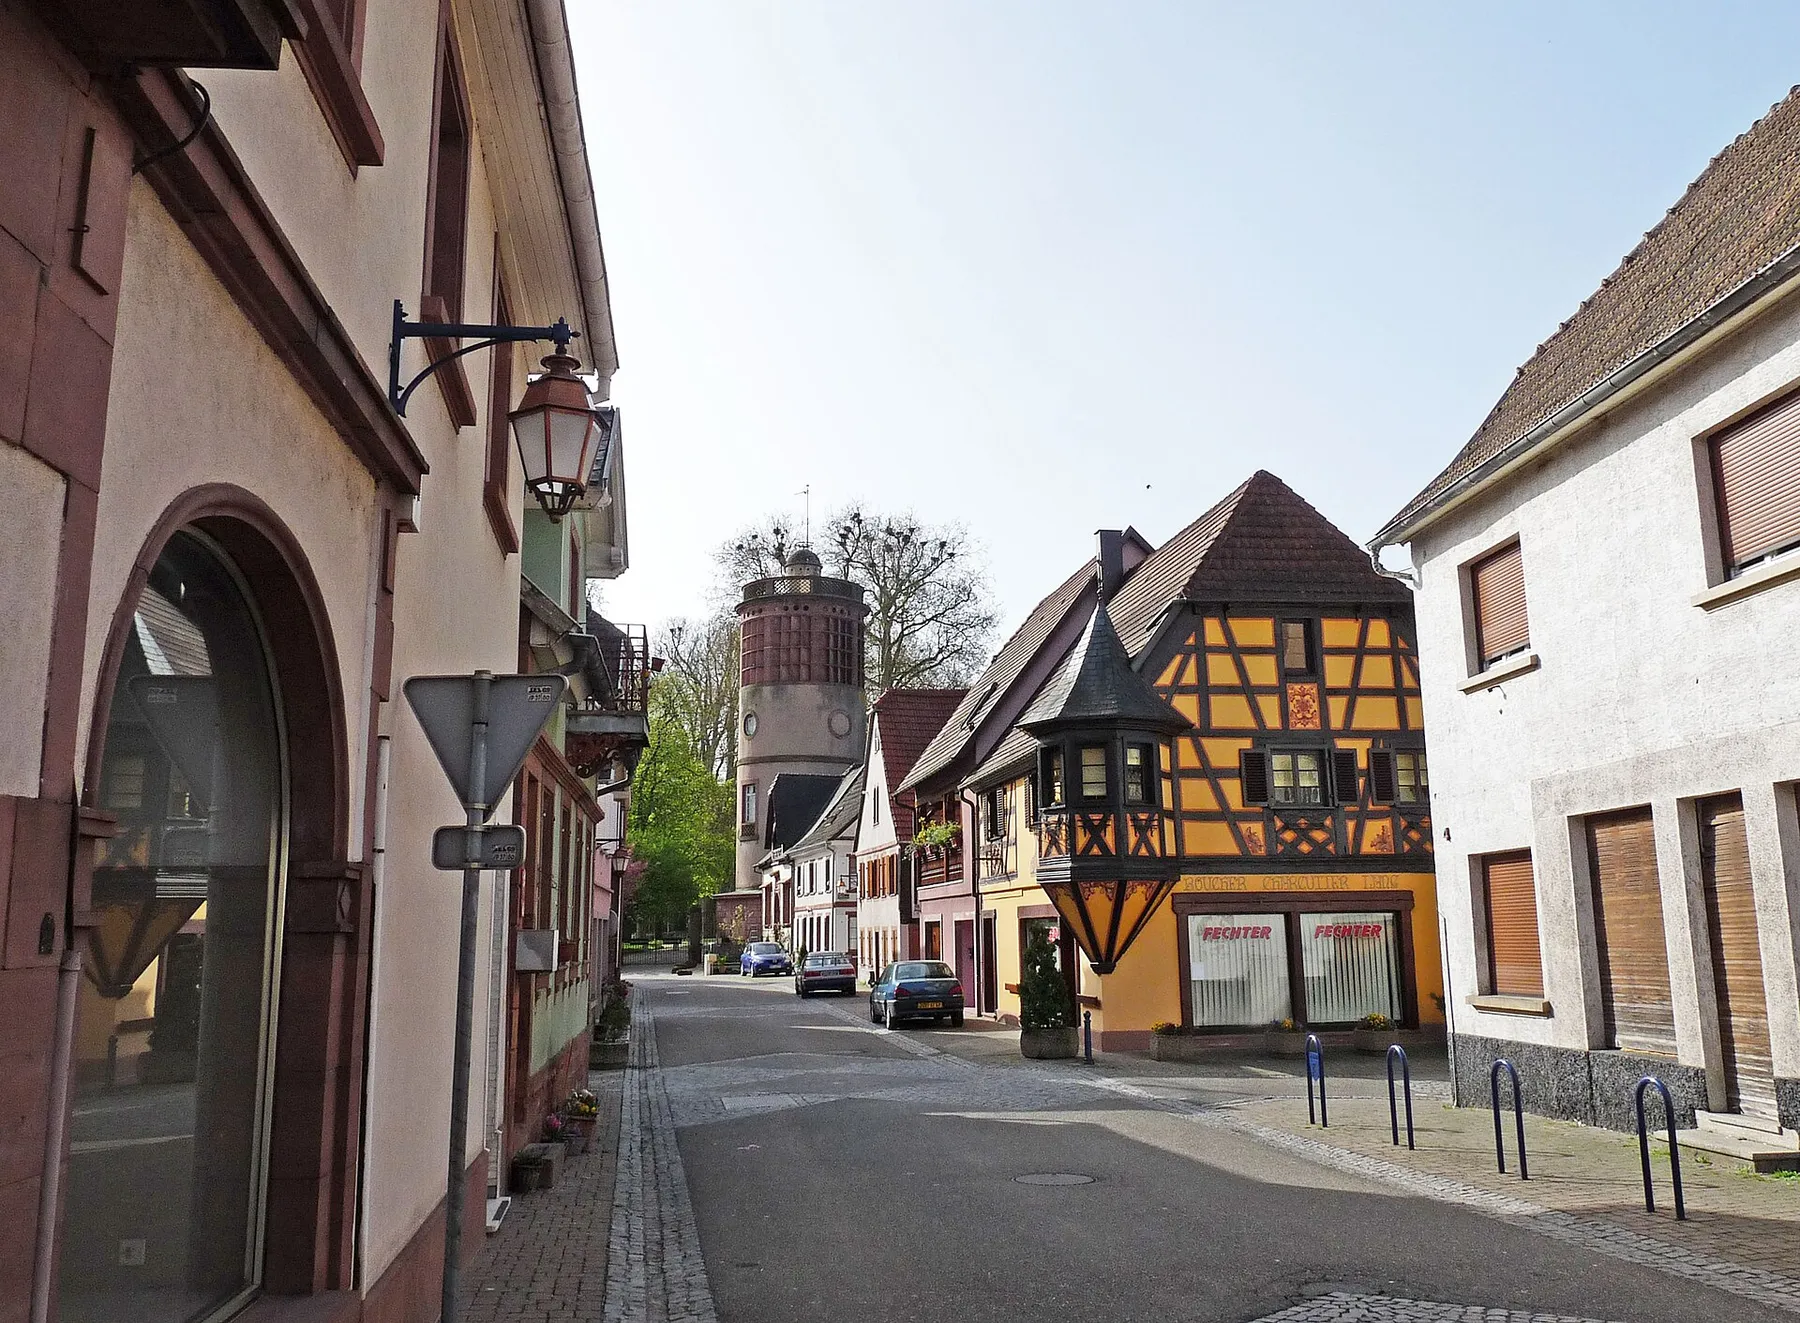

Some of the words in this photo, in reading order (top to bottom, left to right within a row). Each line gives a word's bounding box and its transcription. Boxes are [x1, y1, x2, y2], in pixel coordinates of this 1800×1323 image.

[1183, 876, 1248, 891] BOUCHER
[1202, 926, 1272, 941] FECHTER
[1314, 924, 1383, 939] FECHTER
